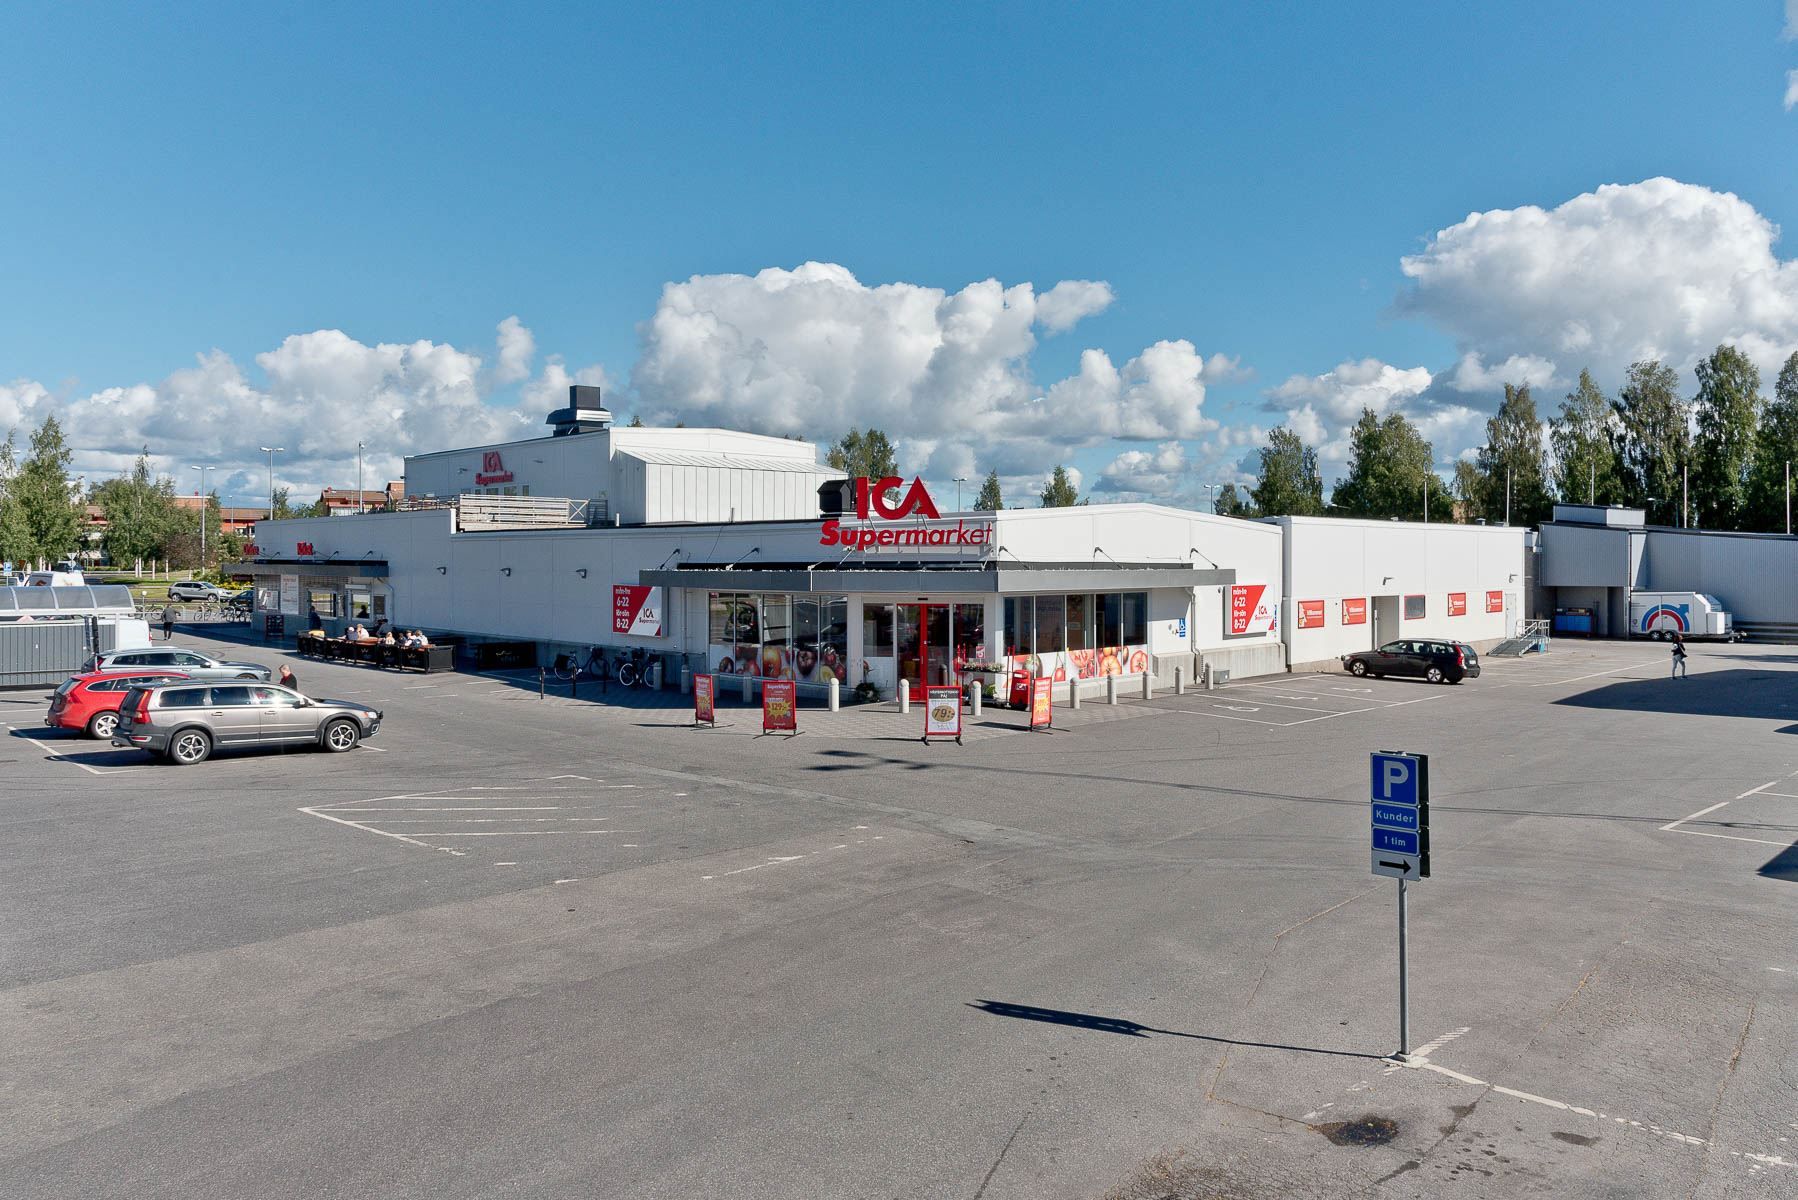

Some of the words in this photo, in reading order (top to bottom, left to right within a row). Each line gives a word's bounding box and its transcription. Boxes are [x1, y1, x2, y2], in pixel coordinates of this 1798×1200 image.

[483, 451, 503, 472] ICA
[857, 476, 941, 520] ICA
[820, 520, 992, 551] Supermarket
[616, 597, 630, 607] 6-22
[1234, 597, 1246, 607] 6-22
[643, 608, 654, 619] ICA
[1258, 605, 1267, 615] ICA
[616, 618, 629, 629] 8-22
[1234, 618, 1246, 629] 8-22
[1383, 760, 1409, 798] P
[1376, 809, 1414, 823] Kunder
[1384, 836, 1388, 845] 1
[1391, 837, 1406, 847] tim
